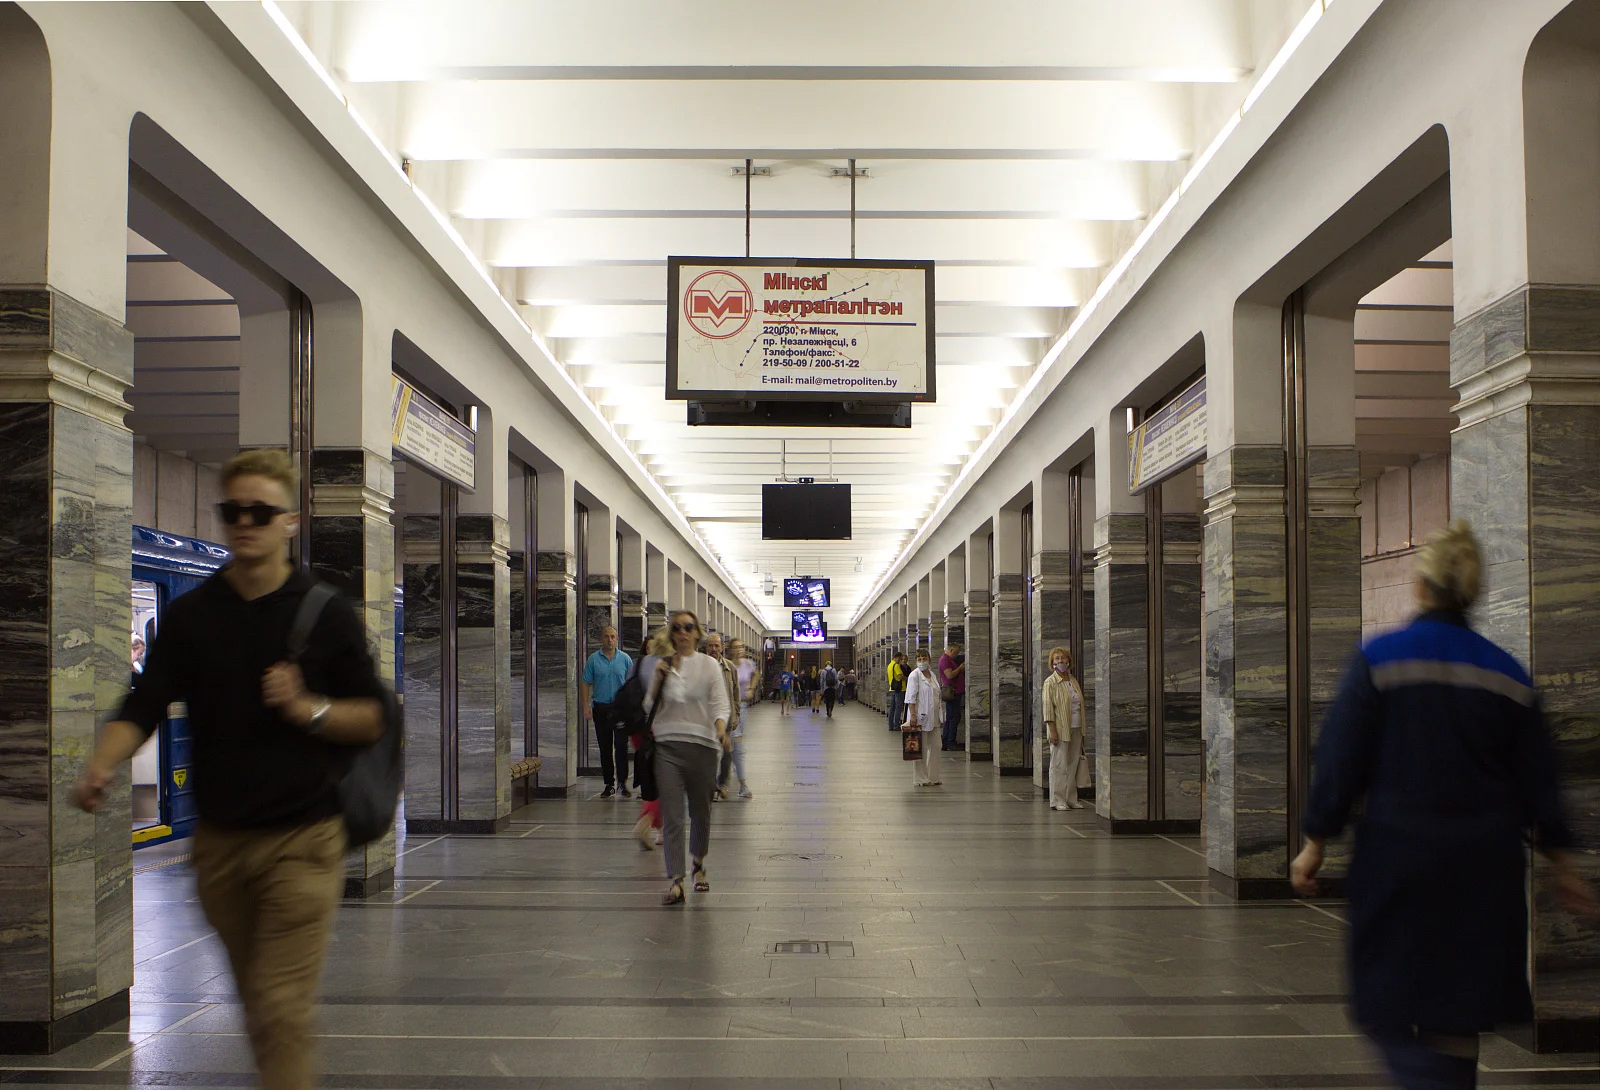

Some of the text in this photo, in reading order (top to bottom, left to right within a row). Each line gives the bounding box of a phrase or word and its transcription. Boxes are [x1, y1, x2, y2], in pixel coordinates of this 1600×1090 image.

[763, 272, 828, 291] Мінскі
[763, 298, 903, 317] метрапалітэн
[763, 326, 798, 336] 220030,
[809, 327, 839, 336] Мінск,
[763, 337, 857, 348] пр. Незалежнасці, 6
[763, 347, 836, 358] Тэлефон/факс:
[762, 358, 808, 367] 219-50-09
[815, 359, 860, 368] 200-51-22
[762, 375, 898, 388] E-mail: mail@metropoliten.by
